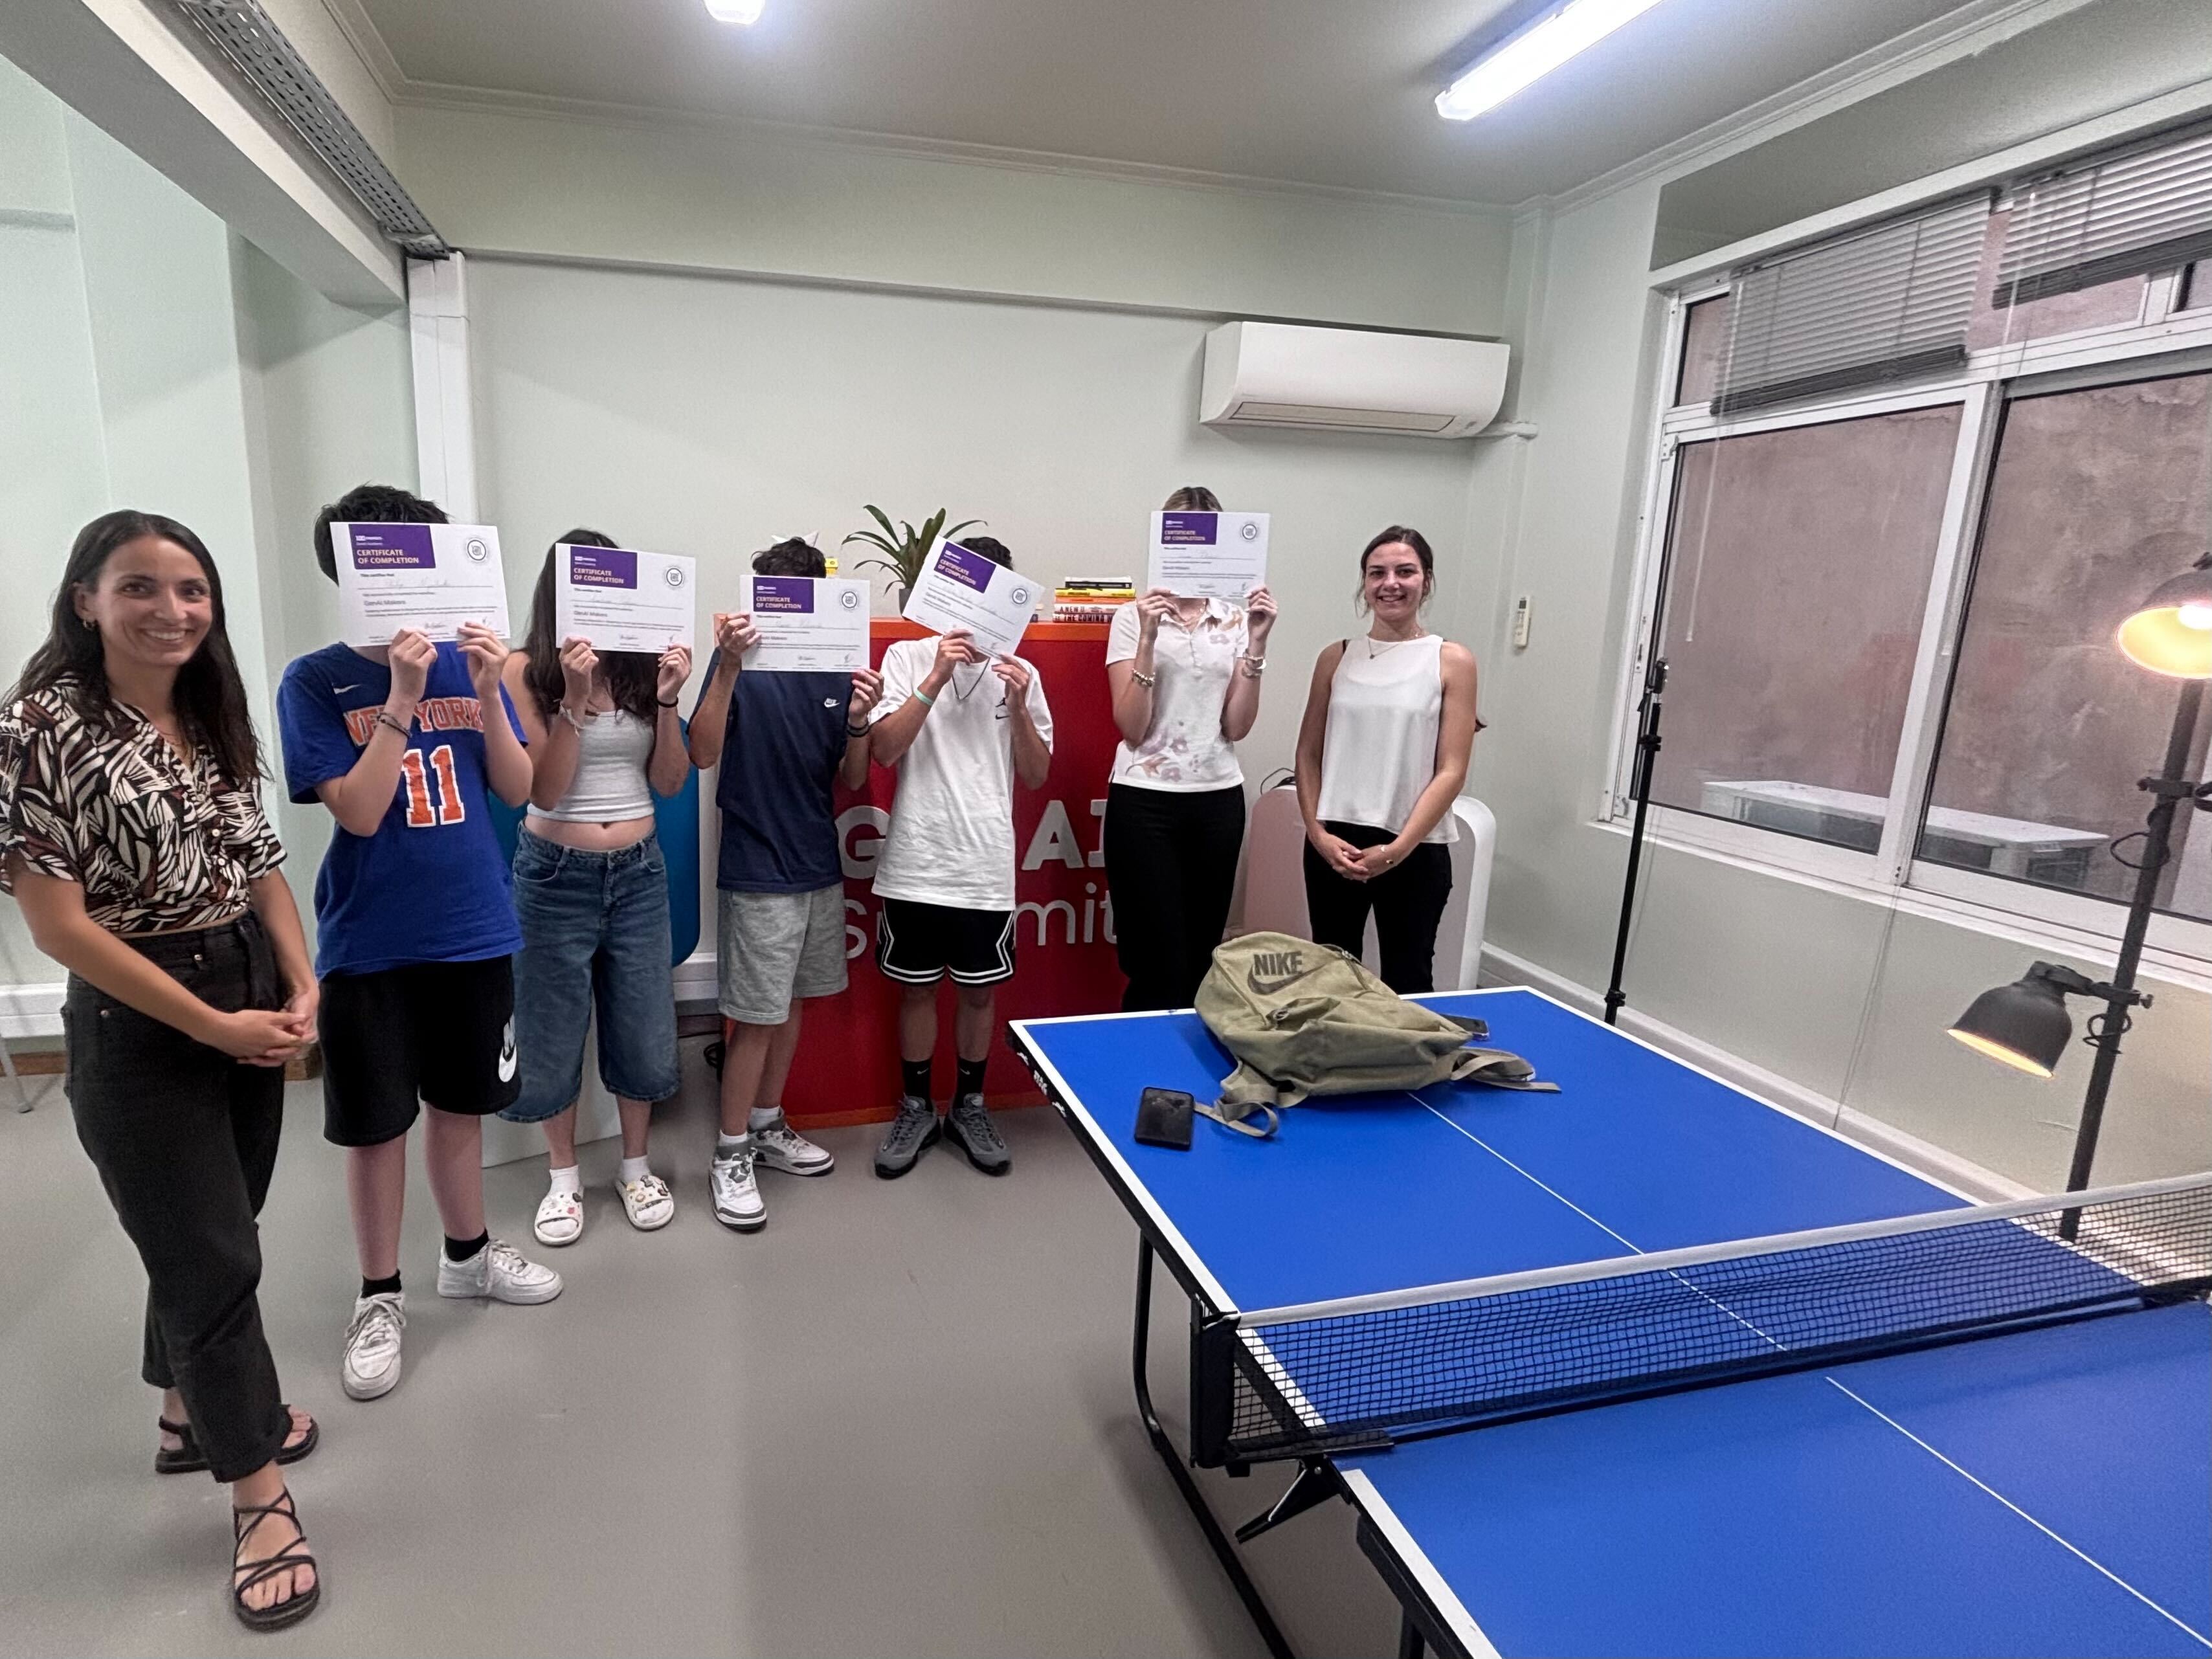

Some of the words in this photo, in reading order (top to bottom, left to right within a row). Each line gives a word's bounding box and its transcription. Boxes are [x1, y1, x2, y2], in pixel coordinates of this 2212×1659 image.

[574, 568, 612, 577] CERTIFICATE
[584, 575, 624, 584] COMPLETION
[343, 704, 386, 746] NE
[414, 696, 484, 733] YORK
[401, 744, 465, 828] 11
[1253, 950, 1303, 976] NIKE
